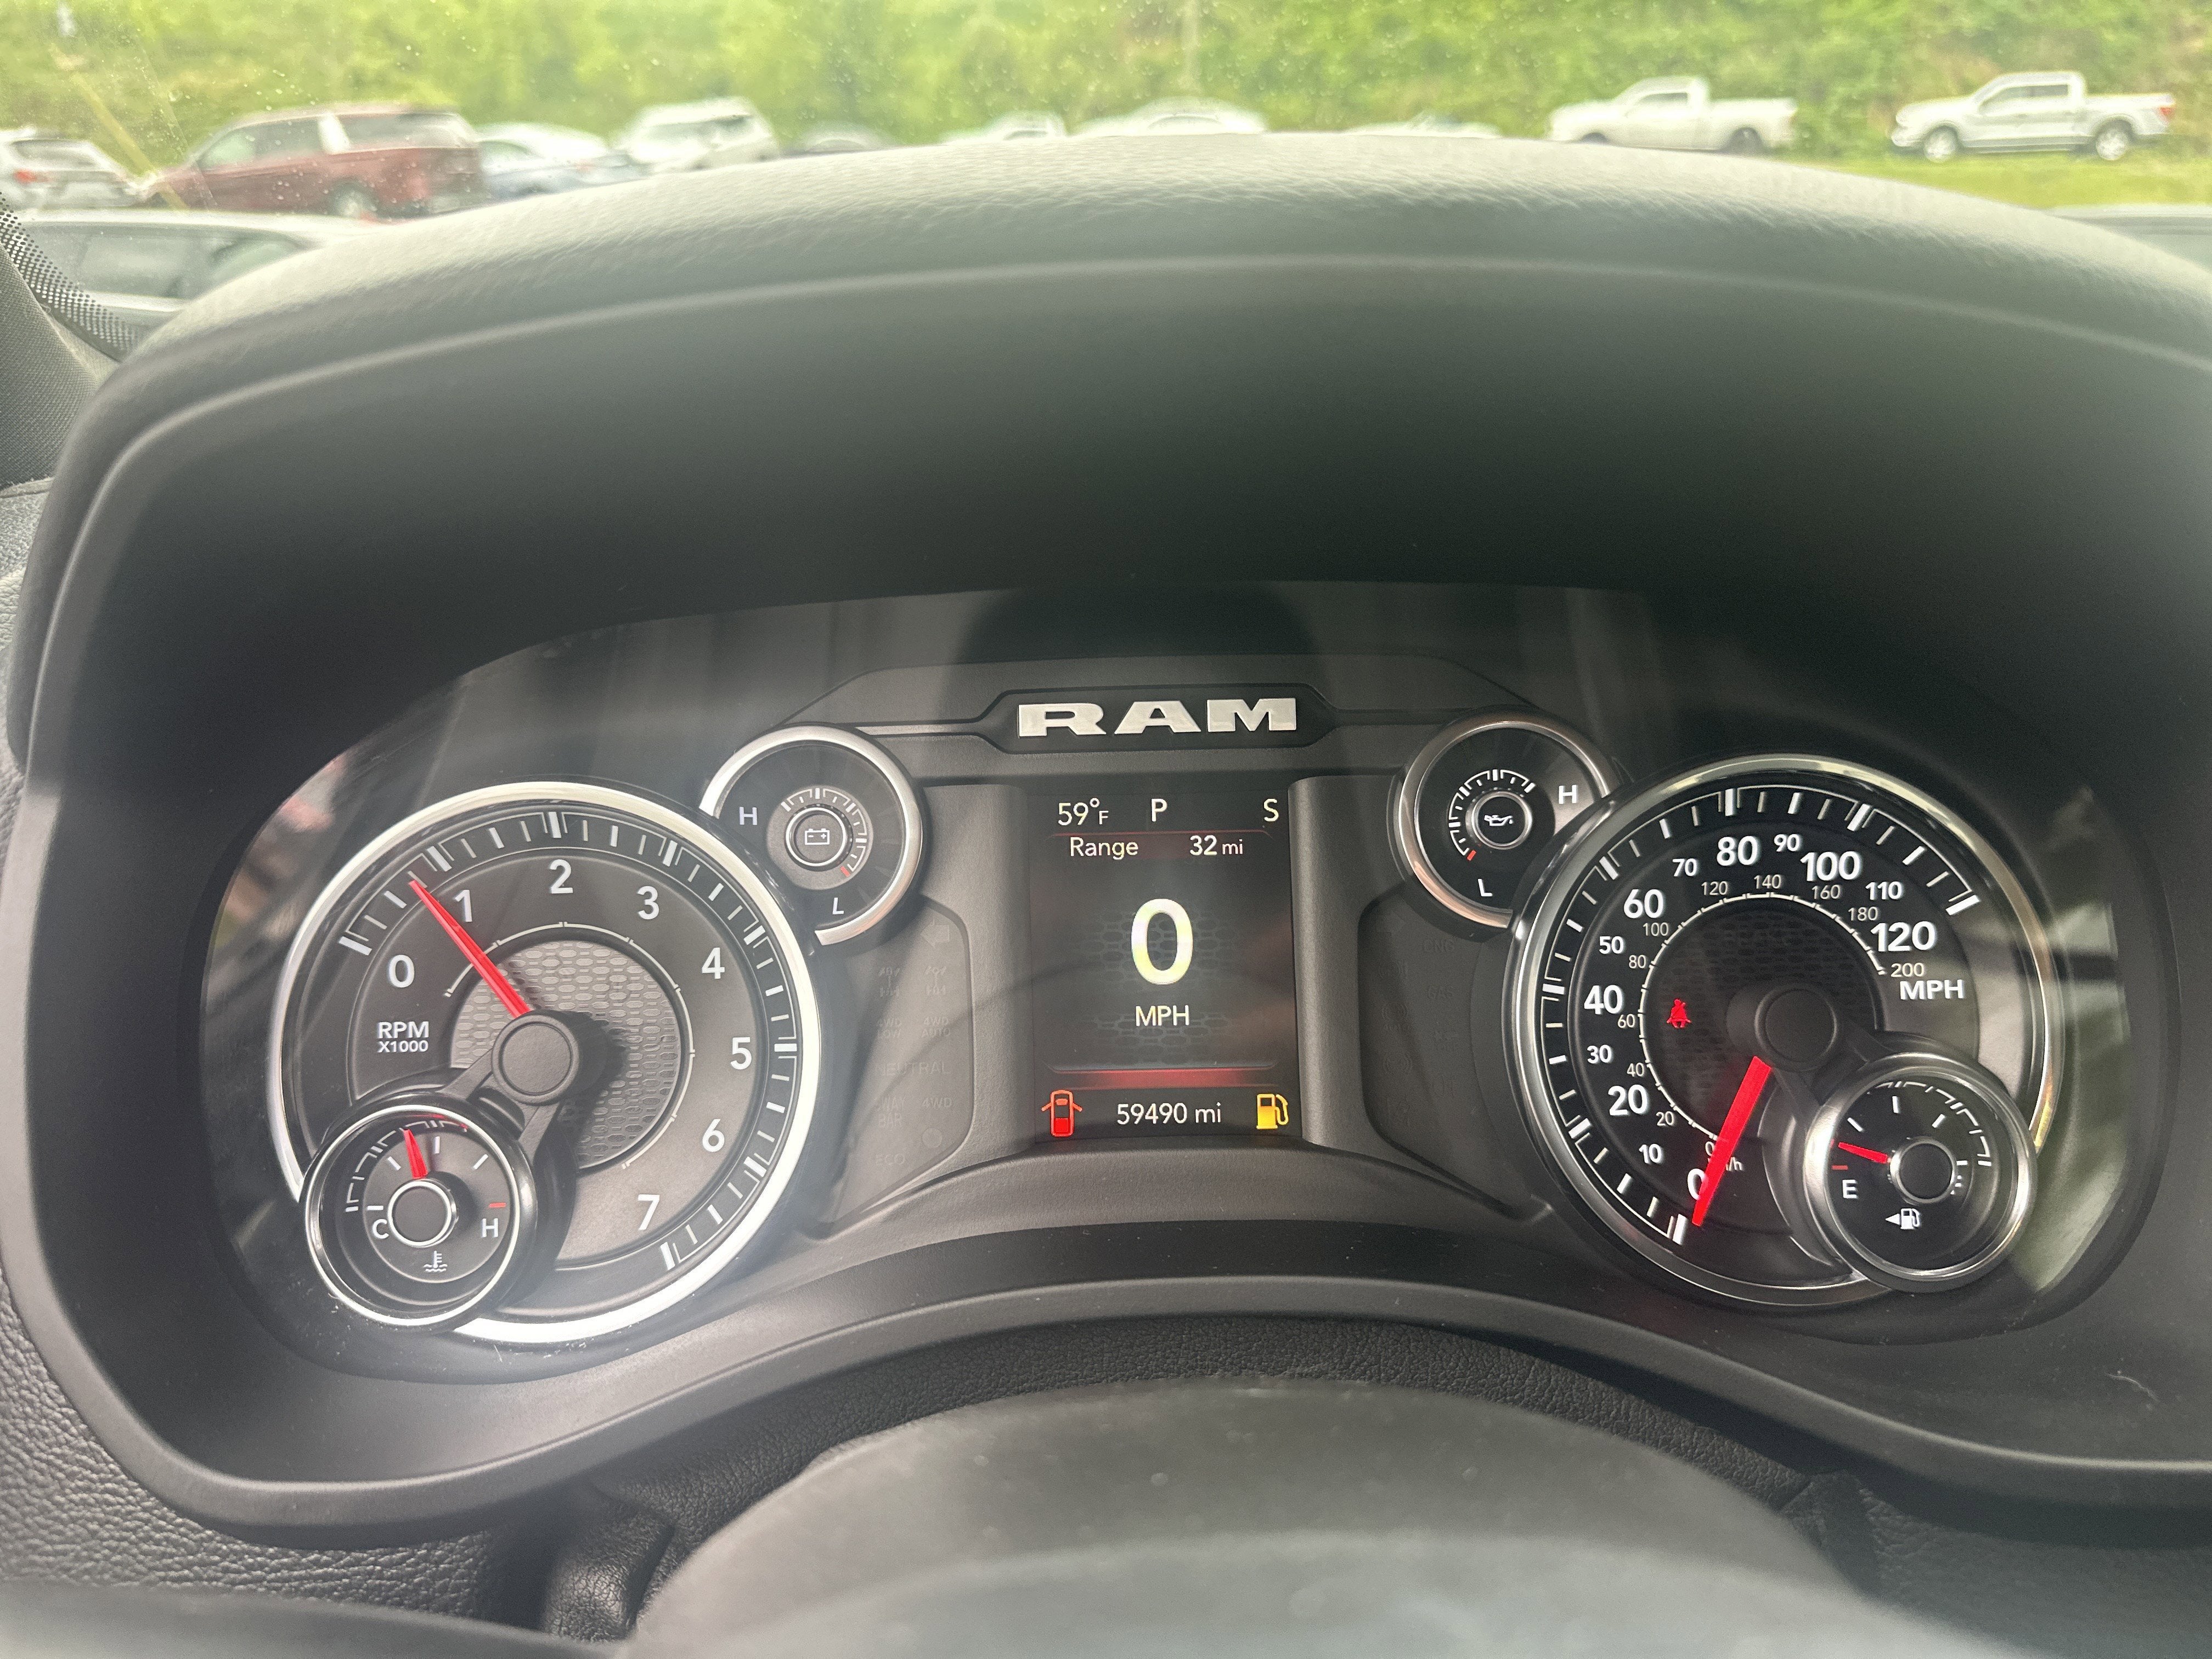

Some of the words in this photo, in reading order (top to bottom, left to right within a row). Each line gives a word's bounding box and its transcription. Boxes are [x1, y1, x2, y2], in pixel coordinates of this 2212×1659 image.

[1018, 698, 1297, 737] RAM
[1558, 784, 1579, 805] H
[739, 806, 758, 826] H
[1151, 798, 1167, 822] P
[1263, 798, 1279, 822] S
[1070, 837, 1139, 860] Range
[1189, 834, 1217, 856] 32
[1222, 839, 1243, 855] mi
[1716, 836, 1759, 866] 80
[1774, 833, 1801, 852] 90
[549, 859, 573, 894] 2
[1672, 858, 1698, 877] 70
[1800, 851, 1861, 882] 100
[1477, 878, 1493, 897] L
[1701, 881, 1728, 895] 120
[1754, 874, 1782, 889] 140
[1812, 884, 1841, 900] 160
[1865, 881, 1903, 900] 110
[453, 889, 472, 922] 1
[637, 885, 659, 920] 3
[832, 897, 844, 915] L
[1623, 889, 1664, 918] 60
[1848, 906, 1878, 921] 180
[1643, 922, 1669, 936] 100
[1870, 920, 1937, 952] 120
[1131, 898, 1193, 985] 0
[1599, 936, 1625, 955] 50
[388, 955, 415, 988] 0
[702, 947, 725, 979] 4
[1628, 955, 1646, 969] 80
[1891, 962, 1927, 978] 200
[1584, 985, 1624, 1015] 40
[1899, 979, 1964, 1000] MPH
[1136, 1005, 1189, 1027] MPH
[1617, 1013, 1635, 1029] 60
[378, 1021, 429, 1039] RPM
[377, 1040, 428, 1053] X1000
[730, 1036, 752, 1070] 5
[1587, 1044, 1613, 1064] 30
[1627, 1062, 1645, 1077] 40
[1608, 1084, 1649, 1116] 20
[1117, 1102, 1187, 1125] 59490
[1195, 1102, 1221, 1123] mi
[1656, 1111, 1675, 1126] 20
[702, 1119, 725, 1153] 6
[1639, 1143, 1663, 1164] 10
[1688, 1168, 1709, 1200] 0
[1842, 1179, 1858, 1199] E
[637, 1194, 660, 1231] 7
[371, 1218, 390, 1240] C
[482, 1218, 499, 1238] H
